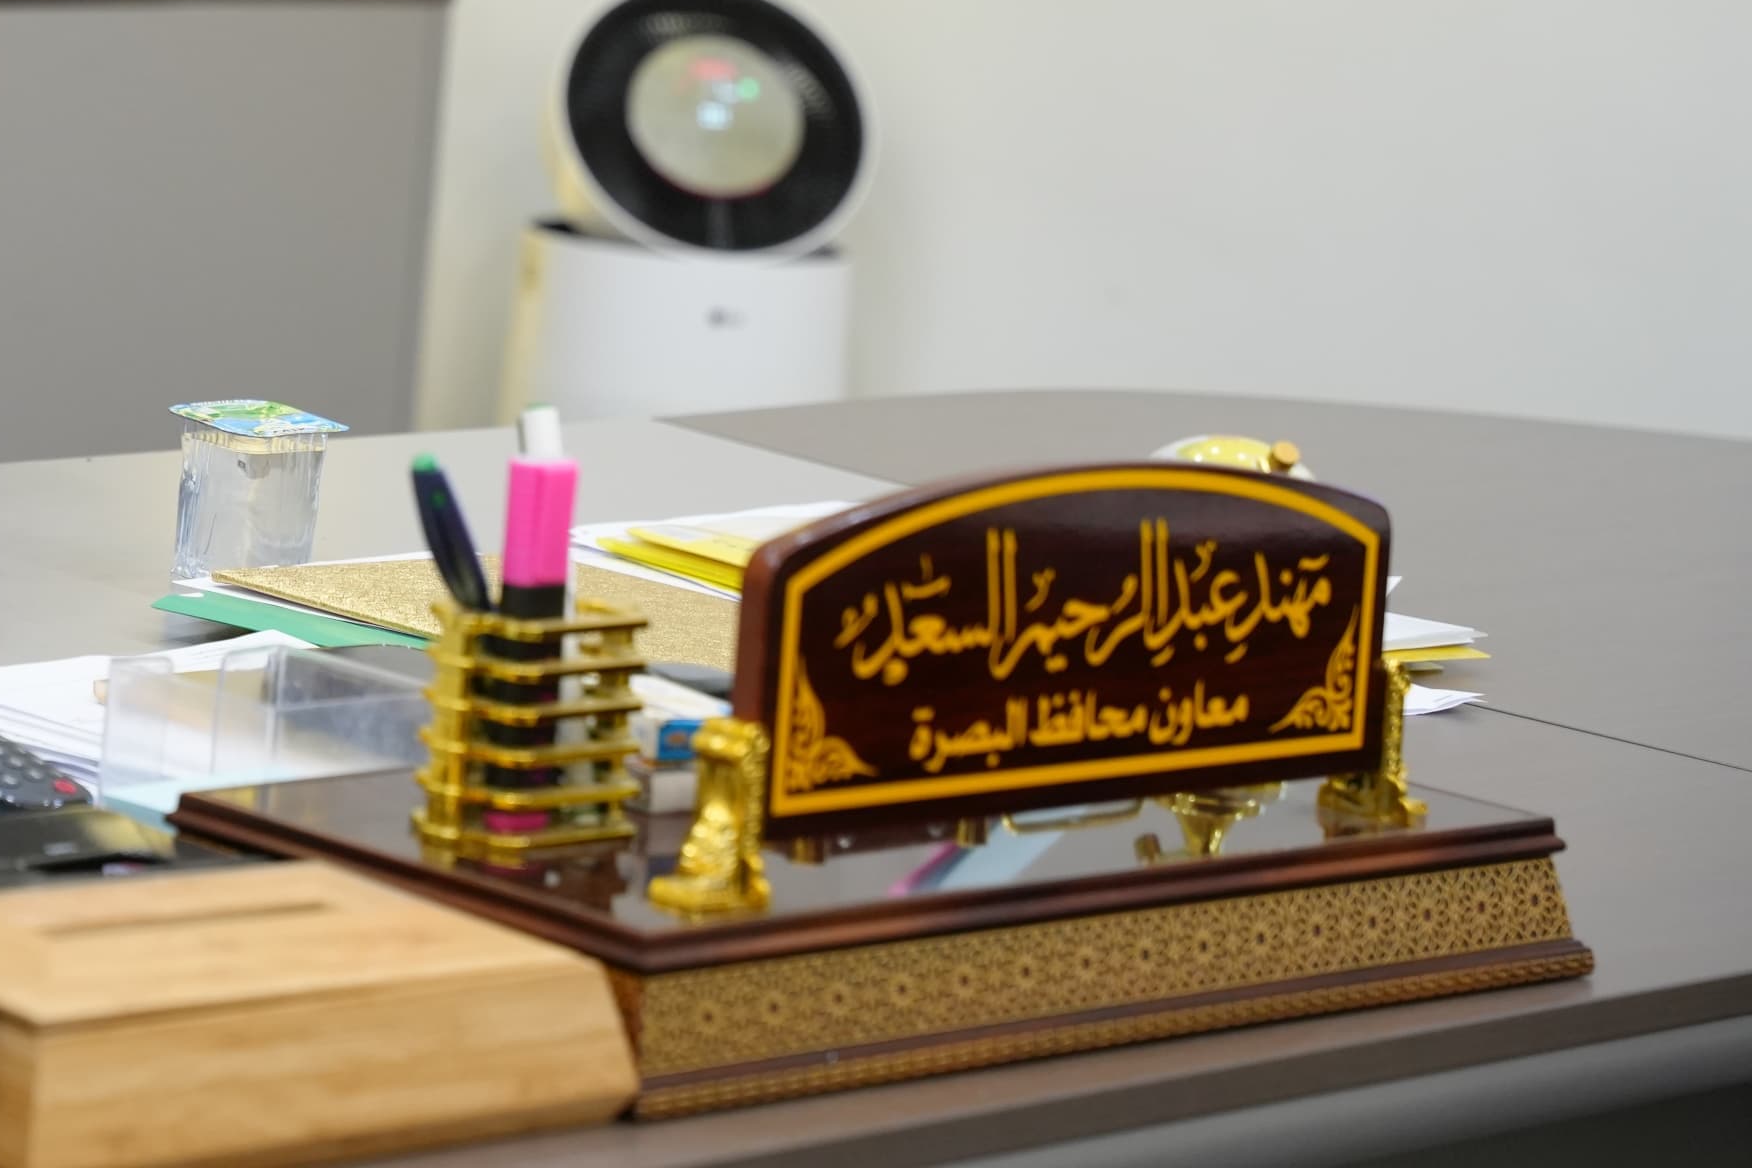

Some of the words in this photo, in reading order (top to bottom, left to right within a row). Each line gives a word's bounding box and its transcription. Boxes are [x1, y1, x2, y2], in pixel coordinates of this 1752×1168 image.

[987, 517, 1170, 680] الرحيم
[1144, 540, 1247, 667] عبد
[1225, 551, 1332, 665] مهند
[908, 696, 1028, 773] البصرة
[1028, 689, 1148, 747] محافظ
[1149, 680, 1249, 746] معاون
